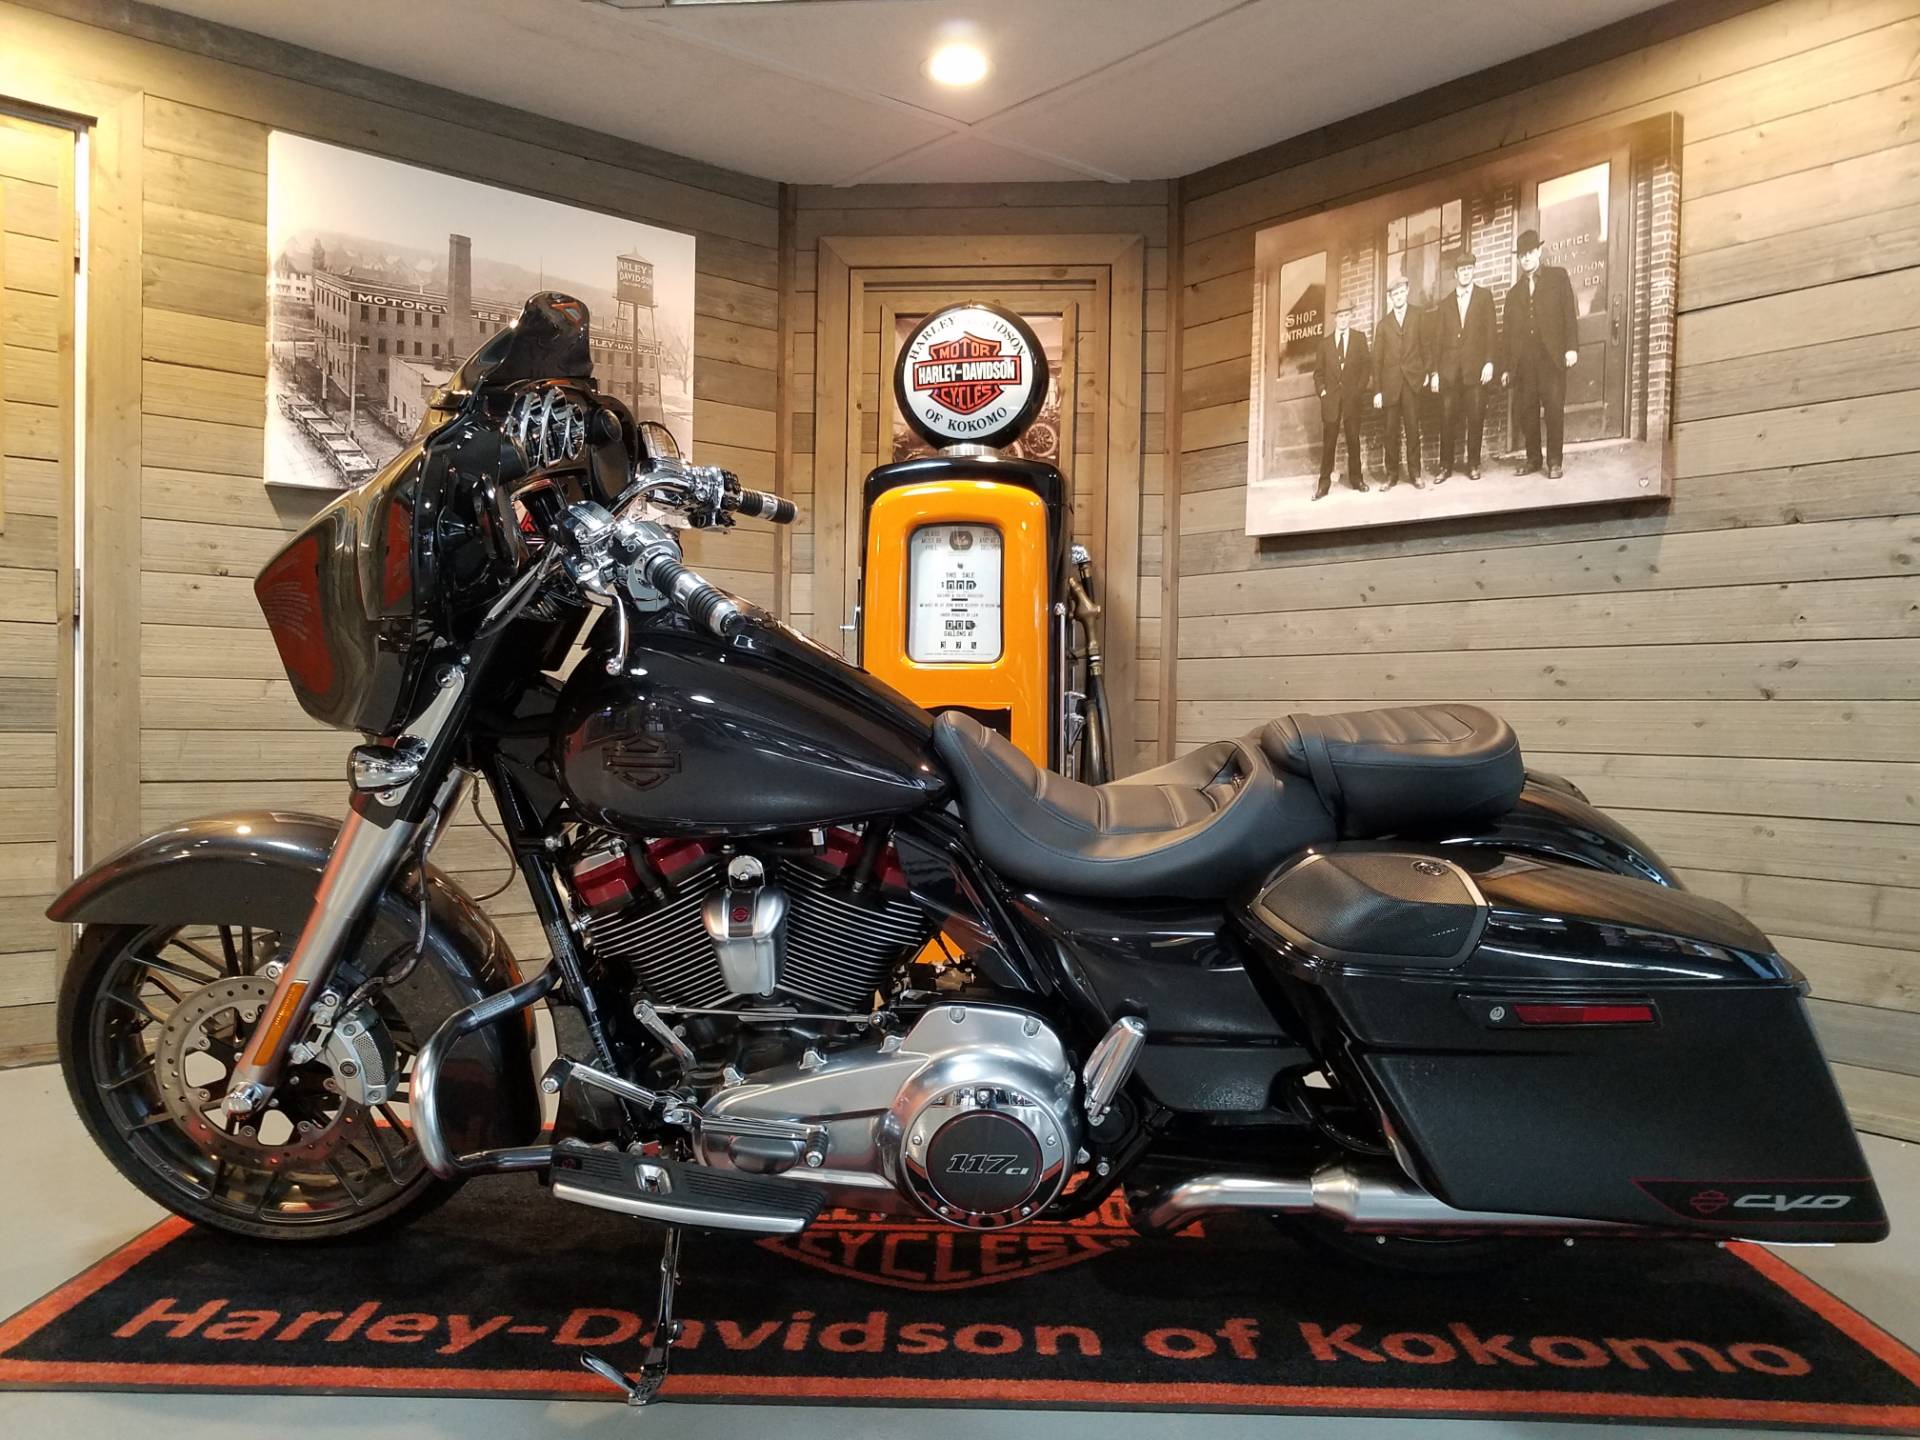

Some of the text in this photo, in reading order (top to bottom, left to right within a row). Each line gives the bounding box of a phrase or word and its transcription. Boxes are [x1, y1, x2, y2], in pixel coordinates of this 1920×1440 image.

[1285, 310, 1317, 328] SHOP
[909, 316, 956, 360] HARLEY
[939, 337, 990, 360] MOTOR
[918, 358, 1015, 385] HARLEY-DAVIDSON
[940, 385, 993, 410] CYCLES
[925, 407, 1007, 433] OF KOKOMO
[946, 1153, 1018, 1175] 117
[1733, 1194, 1853, 1212] CVO
[801, 1231, 1070, 1283] CYCLES
[111, 1297, 1813, 1377] Harley-Davidson of Kokomo
